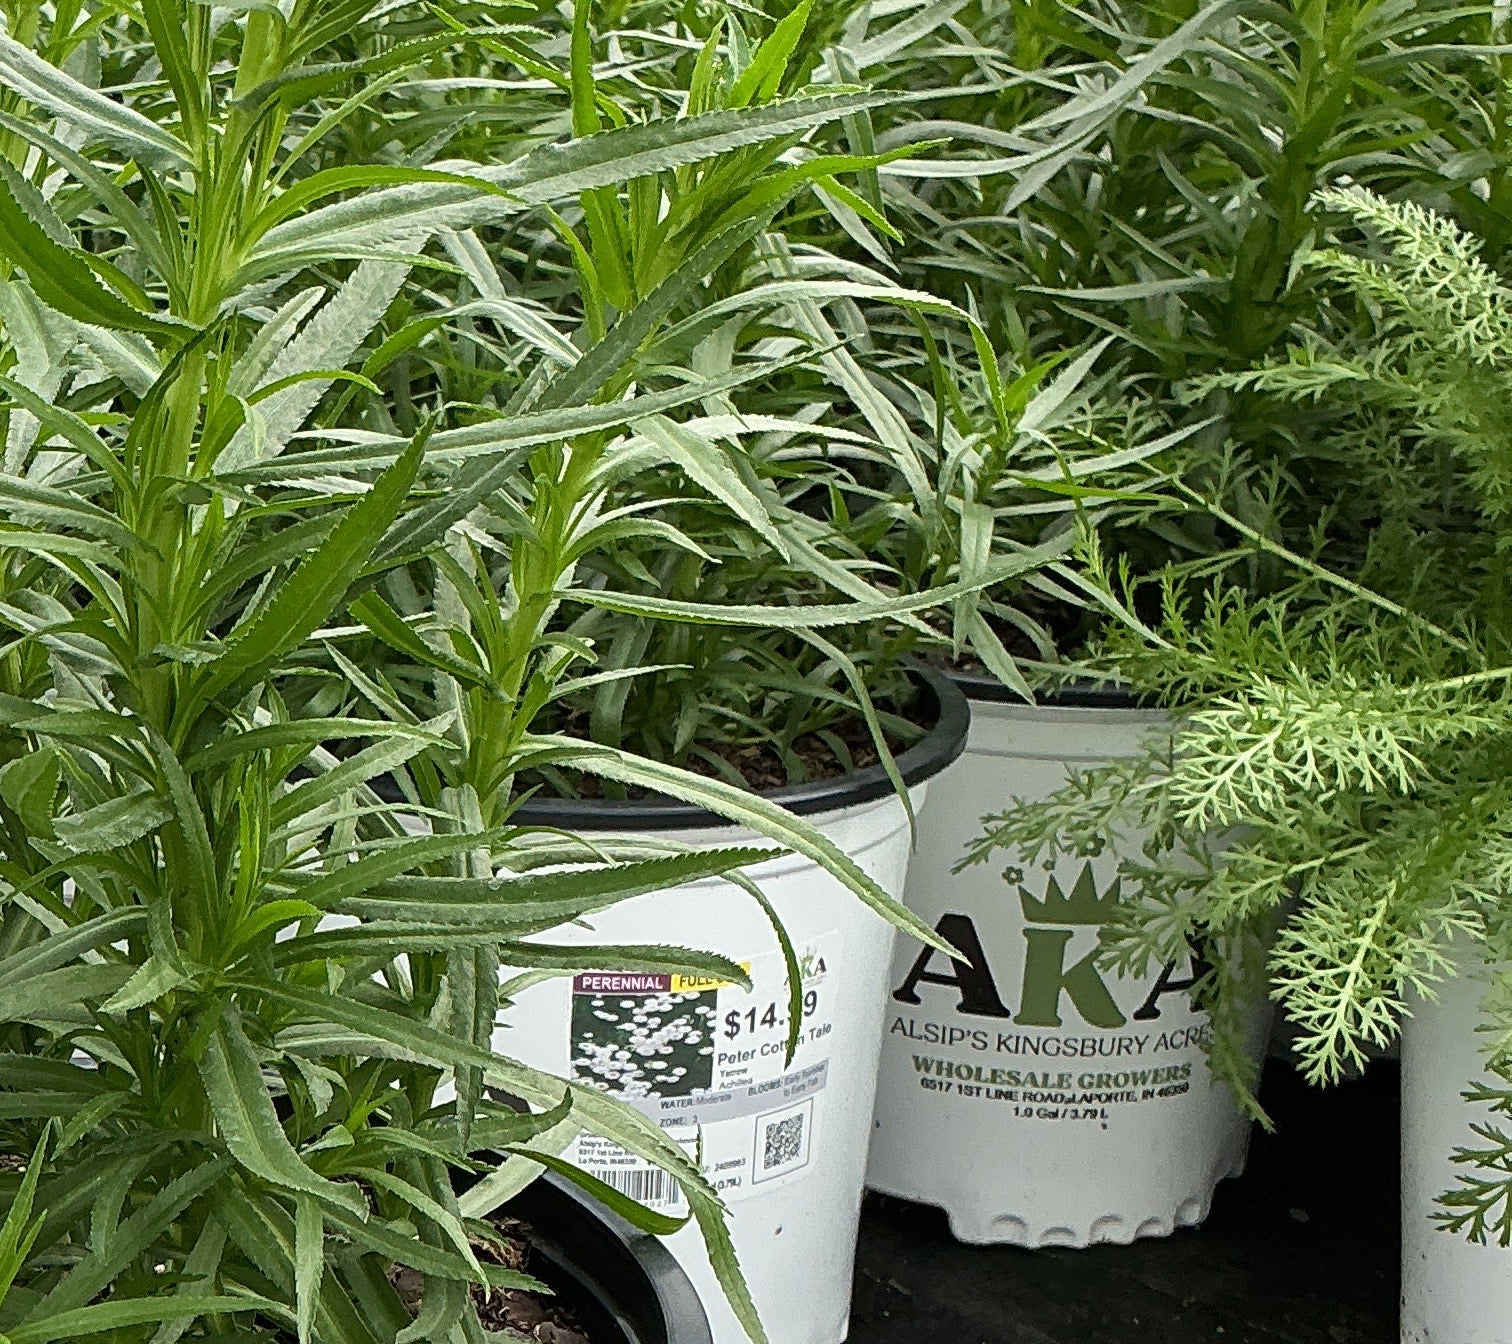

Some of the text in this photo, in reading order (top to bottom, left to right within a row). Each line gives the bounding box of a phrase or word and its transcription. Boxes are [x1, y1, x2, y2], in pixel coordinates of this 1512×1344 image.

[582, 976, 664, 991] PERENNIAL
[723, 990, 818, 1041] $14.9
[890, 1016, 988, 1051] ALSIP'S
[995, 1032, 1150, 1058] KINGSBURY
[717, 1048, 756, 1066] Peter
[911, 1055, 1193, 1090] WHOLESALE GROWERS
[957, 1083, 983, 1098] 1ST
[986, 1087, 1019, 1102] LINE
[1013, 1106, 1033, 1118] 1.0
[1035, 1106, 1059, 1120] Gal
